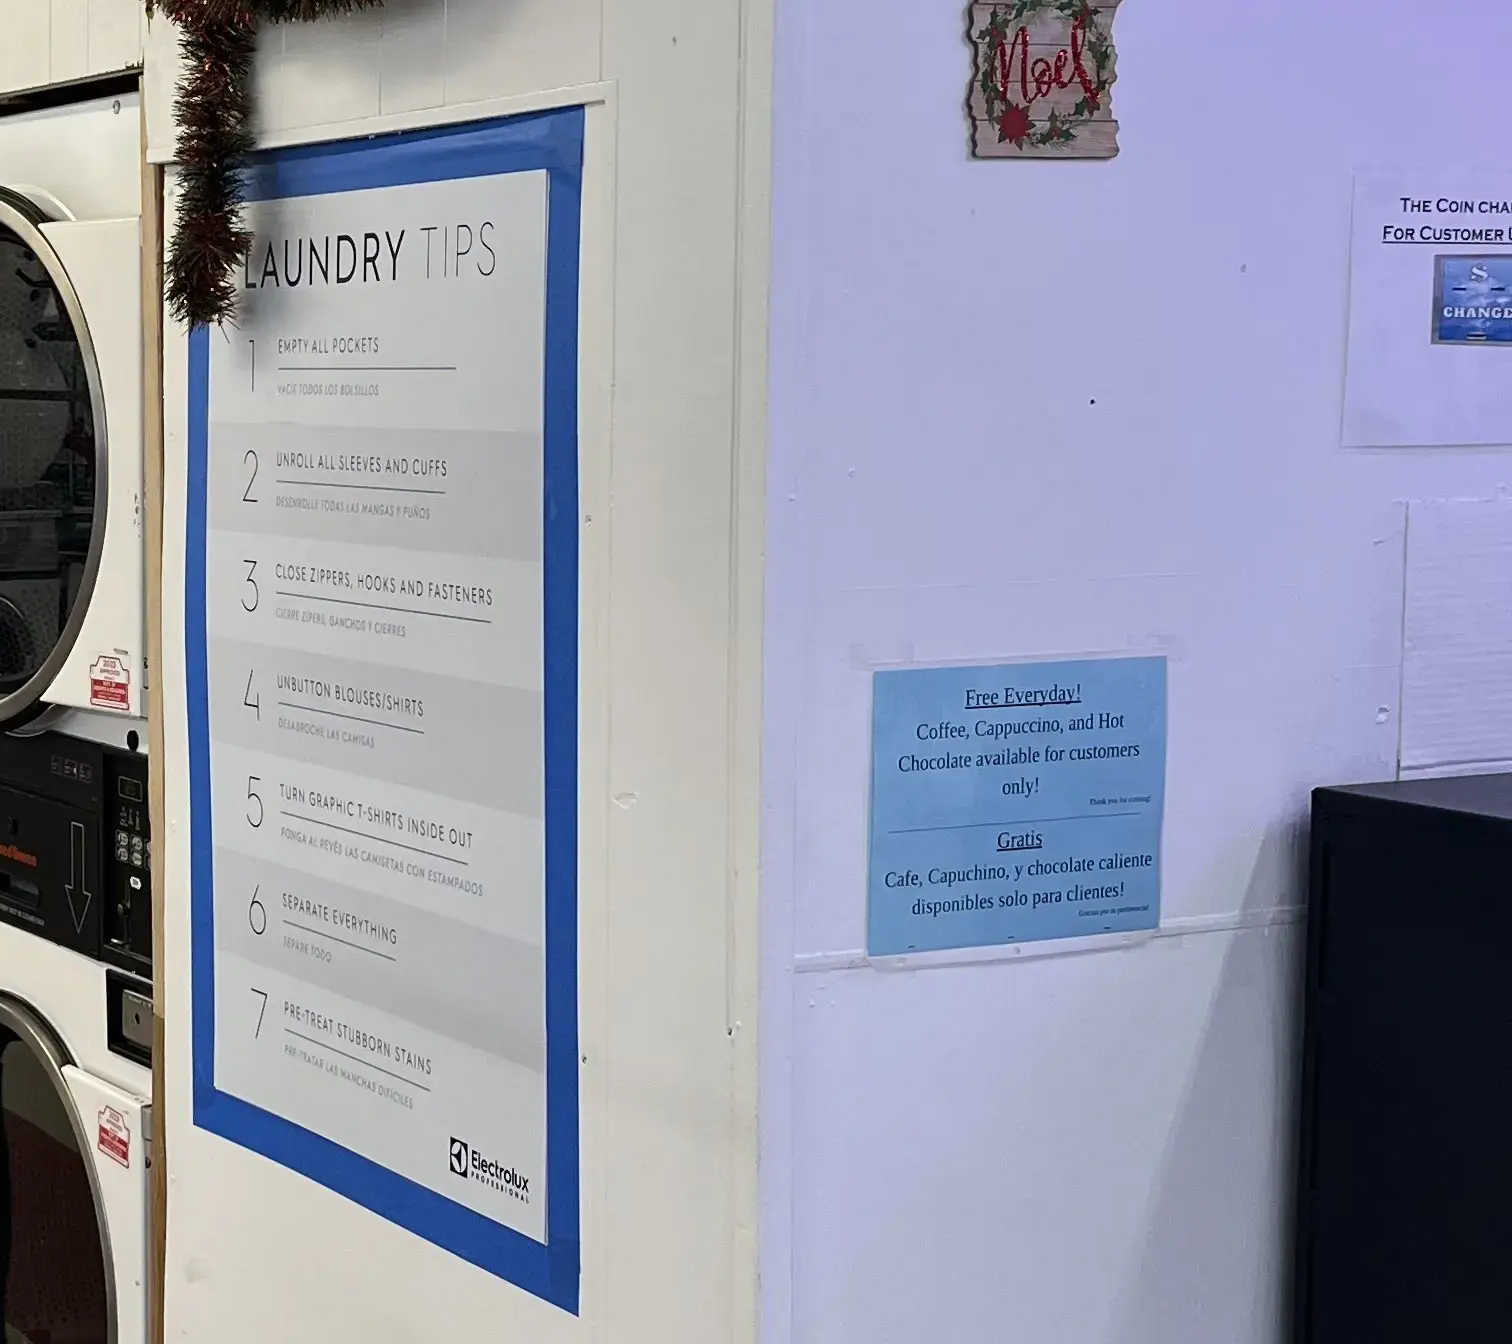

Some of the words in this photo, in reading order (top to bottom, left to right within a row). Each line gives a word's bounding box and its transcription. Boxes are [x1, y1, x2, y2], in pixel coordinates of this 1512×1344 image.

[990, 14, 1102, 105] Noel
[1399, 197, 1432, 212] THE
[1436, 198, 1474, 214] COIN
[1478, 201, 1512, 214] CHA
[1383, 225, 1415, 241] FOR
[1419, 225, 1504, 242] CUSTOMER
[245, 229, 405, 289] LAUNDRY
[420, 222, 496, 278] TIPS
[249, 340, 255, 392] 1
[278, 338, 309, 354] EMPTY
[311, 337, 329, 354] ALL
[332, 336, 379, 354] POCKETS
[243, 449, 258, 502] 2
[276, 452, 315, 469] UNROLL
[317, 454, 336, 470] ALL
[338, 455, 382, 473] SLEEVES
[384, 458, 408, 474] AND
[412, 458, 447, 477] CUFFS
[361, 503, 395, 517] MANGAS
[241, 559, 258, 612] 3
[275, 563, 307, 582] CLOSE
[310, 567, 353, 590] ZIPPERS,
[357, 574, 396, 593] HOOKS
[400, 580, 423, 597] AND
[428, 582, 493, 606] FASTENERS
[244, 669, 260, 721] 4
[277, 674, 331, 699] UNBUTTON
[335, 685, 424, 717] BLOUSES/SHIRTS
[965, 687, 999, 707] Free
[1004, 684, 1082, 708] Everyday!
[916, 719, 971, 741] Coffee,
[975, 716, 1064, 741] Cappuccino,
[1068, 713, 1094, 731] and
[1098, 712, 1125, 729] Hot
[898, 752, 972, 773] Chocolate
[975, 748, 1040, 767] available
[1044, 745, 1066, 763] for
[1069, 742, 1140, 761] customers
[246, 775, 263, 828] 5
[1002, 777, 1039, 798] only!
[279, 783, 305, 804] TURN
[308, 791, 355, 817] GRAPHIC
[357, 803, 404, 831] T-SHIRTS
[407, 818, 444, 842] INSIDE
[448, 828, 473, 849] OUT
[997, 829, 1043, 849] Gratis
[344, 844, 359, 859] LAS
[360, 848, 404, 874] CAMISETAS
[406, 863, 425, 879] CON
[427, 869, 483, 897] ESTAMPADOS
[884, 870, 923, 889] Cafe,
[928, 863, 1010, 887] Capuchino,
[1014, 867, 1024, 881] y
[1027, 857, 1094, 877] chocolate
[1098, 853, 1153, 869] caliente
[249, 884, 267, 935] 6
[282, 892, 329, 922] SEPARATE
[332, 909, 397, 945] EVERYTHING
[912, 892, 994, 917] disponibles
[998, 891, 1028, 907] solo
[1032, 889, 1062, 909] para
[1067, 881, 1125, 903] clientes!
[250, 987, 268, 1039] 7
[284, 1000, 334, 1035] PRE-TREAT
[337, 1022, 391, 1058] STUBBORN
[395, 1046, 432, 1075] STAINS
[471, 1149, 529, 1193] Electrolux
[471, 1170, 529, 1204] PROFESSIONAL
